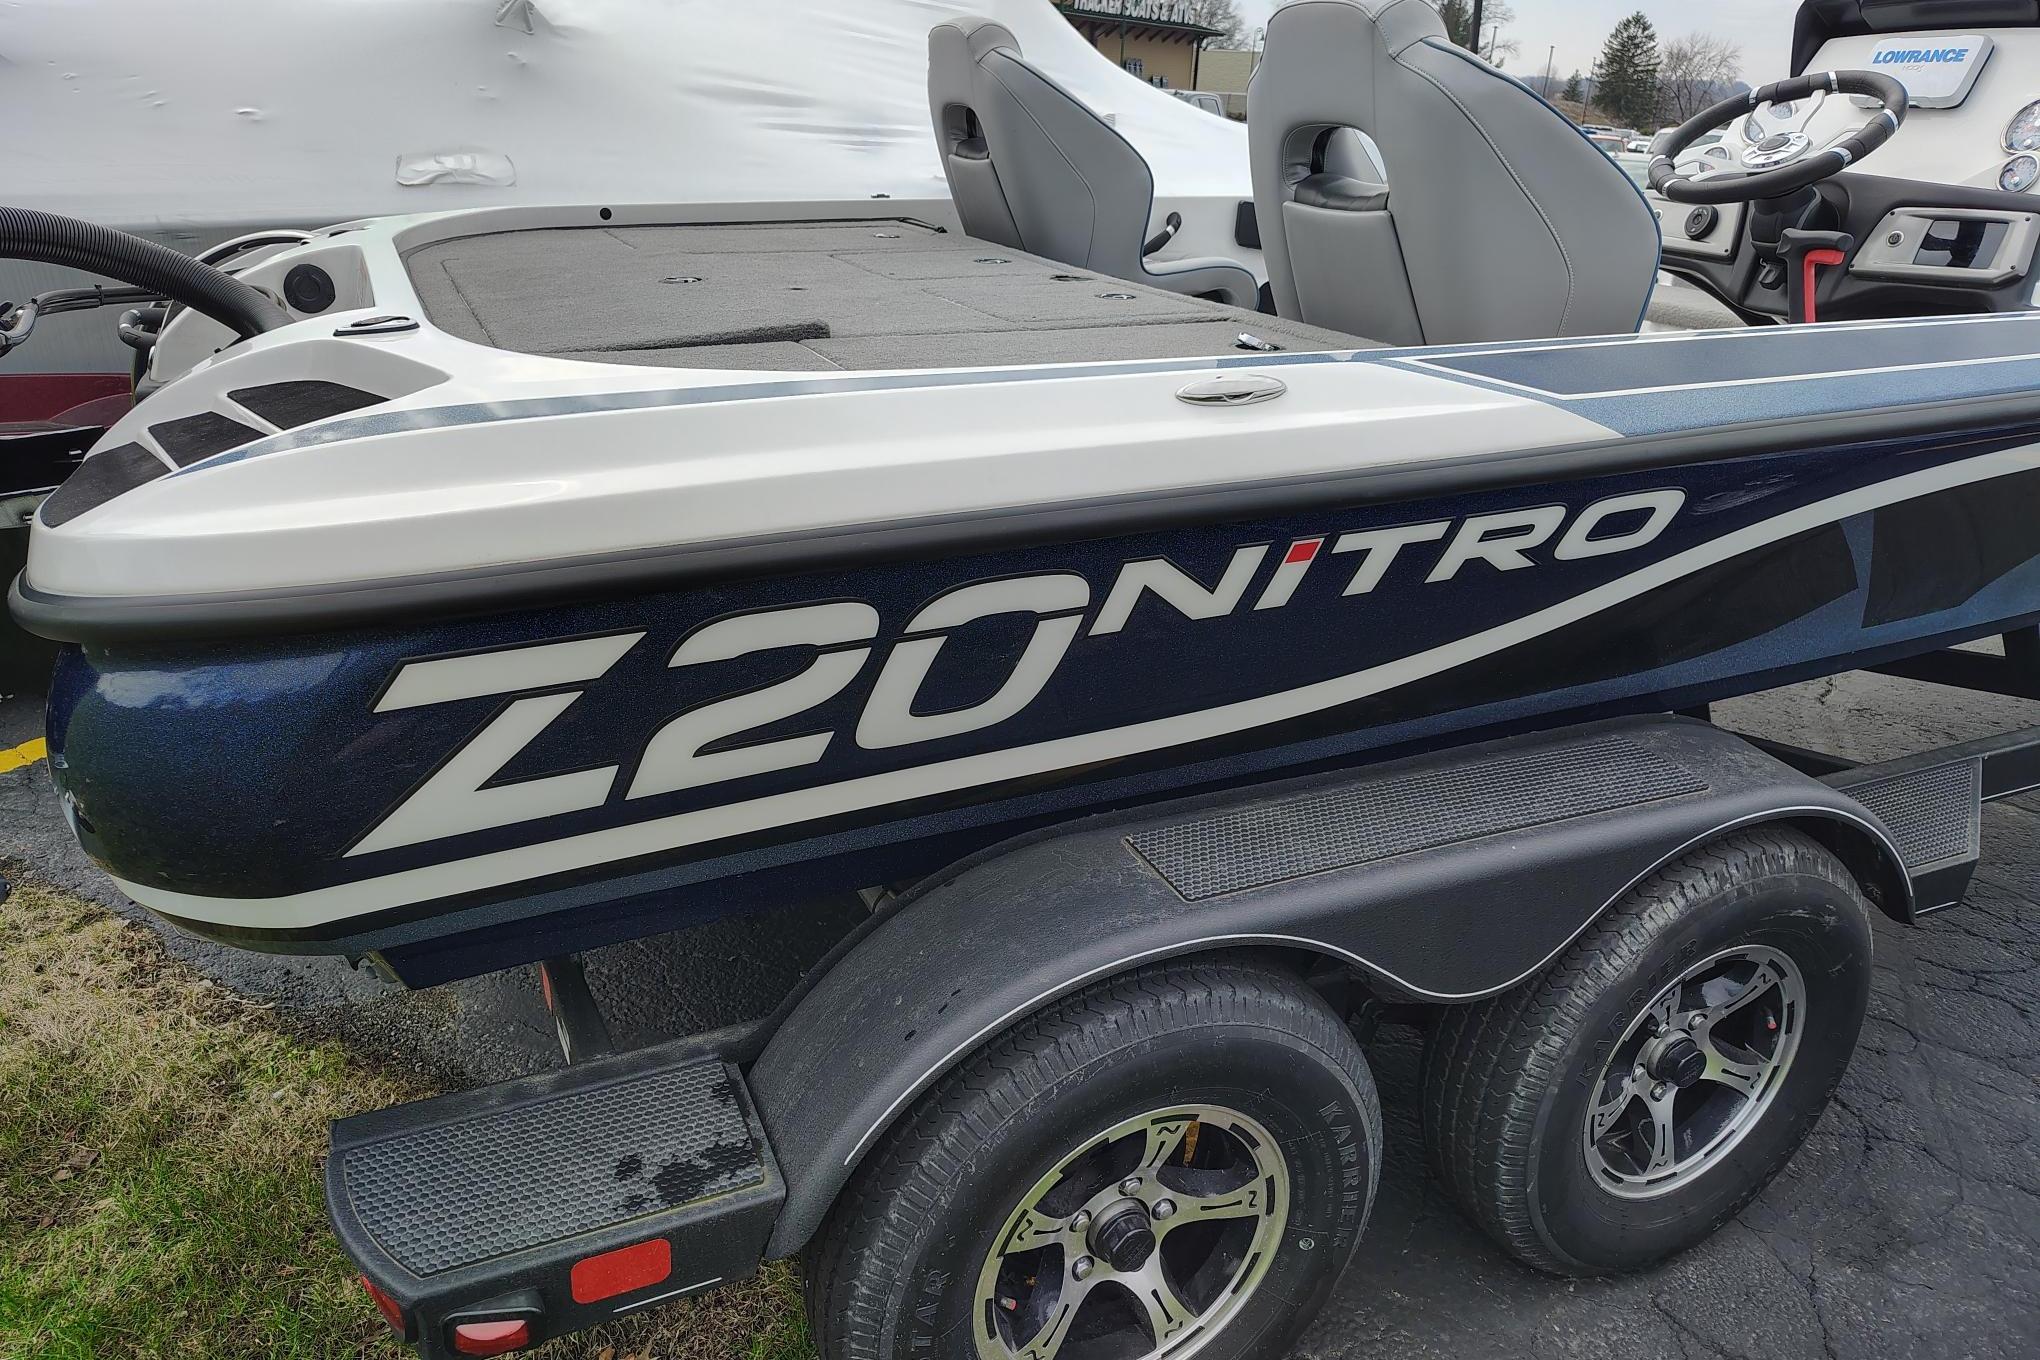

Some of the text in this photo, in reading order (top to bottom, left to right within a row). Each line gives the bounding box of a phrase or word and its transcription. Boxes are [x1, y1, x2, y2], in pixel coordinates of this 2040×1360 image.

[1872, 48, 1969, 64] LOWRANCE
[340, 488, 1688, 859] Z20 NITRO
